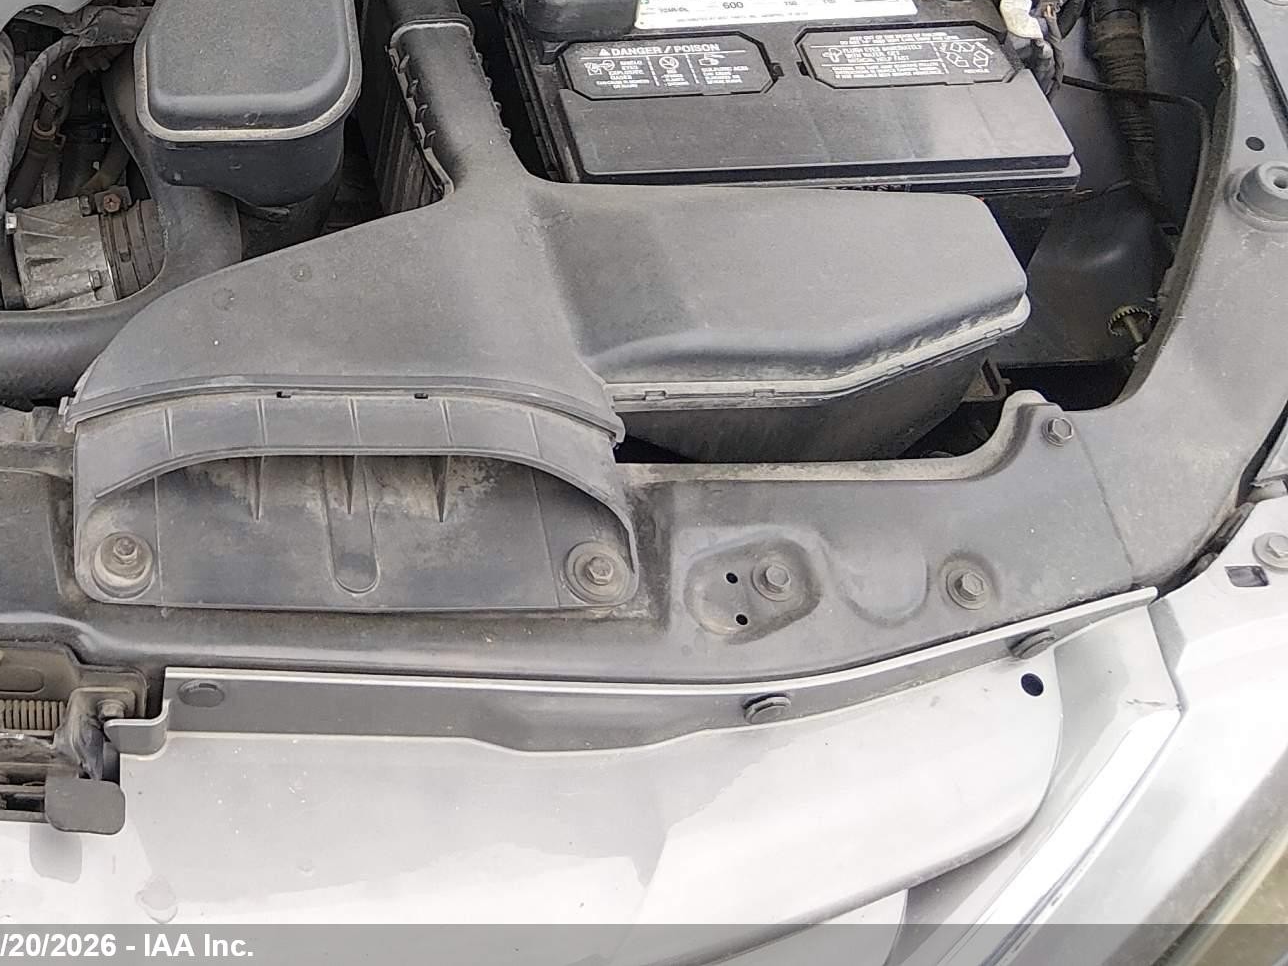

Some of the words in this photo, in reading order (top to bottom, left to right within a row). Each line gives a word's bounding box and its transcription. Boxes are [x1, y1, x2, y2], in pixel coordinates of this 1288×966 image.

[722, 1, 744, 9] 600
[612, 45, 662, 56] DANGER
[673, 43, 720, 53] POISON
